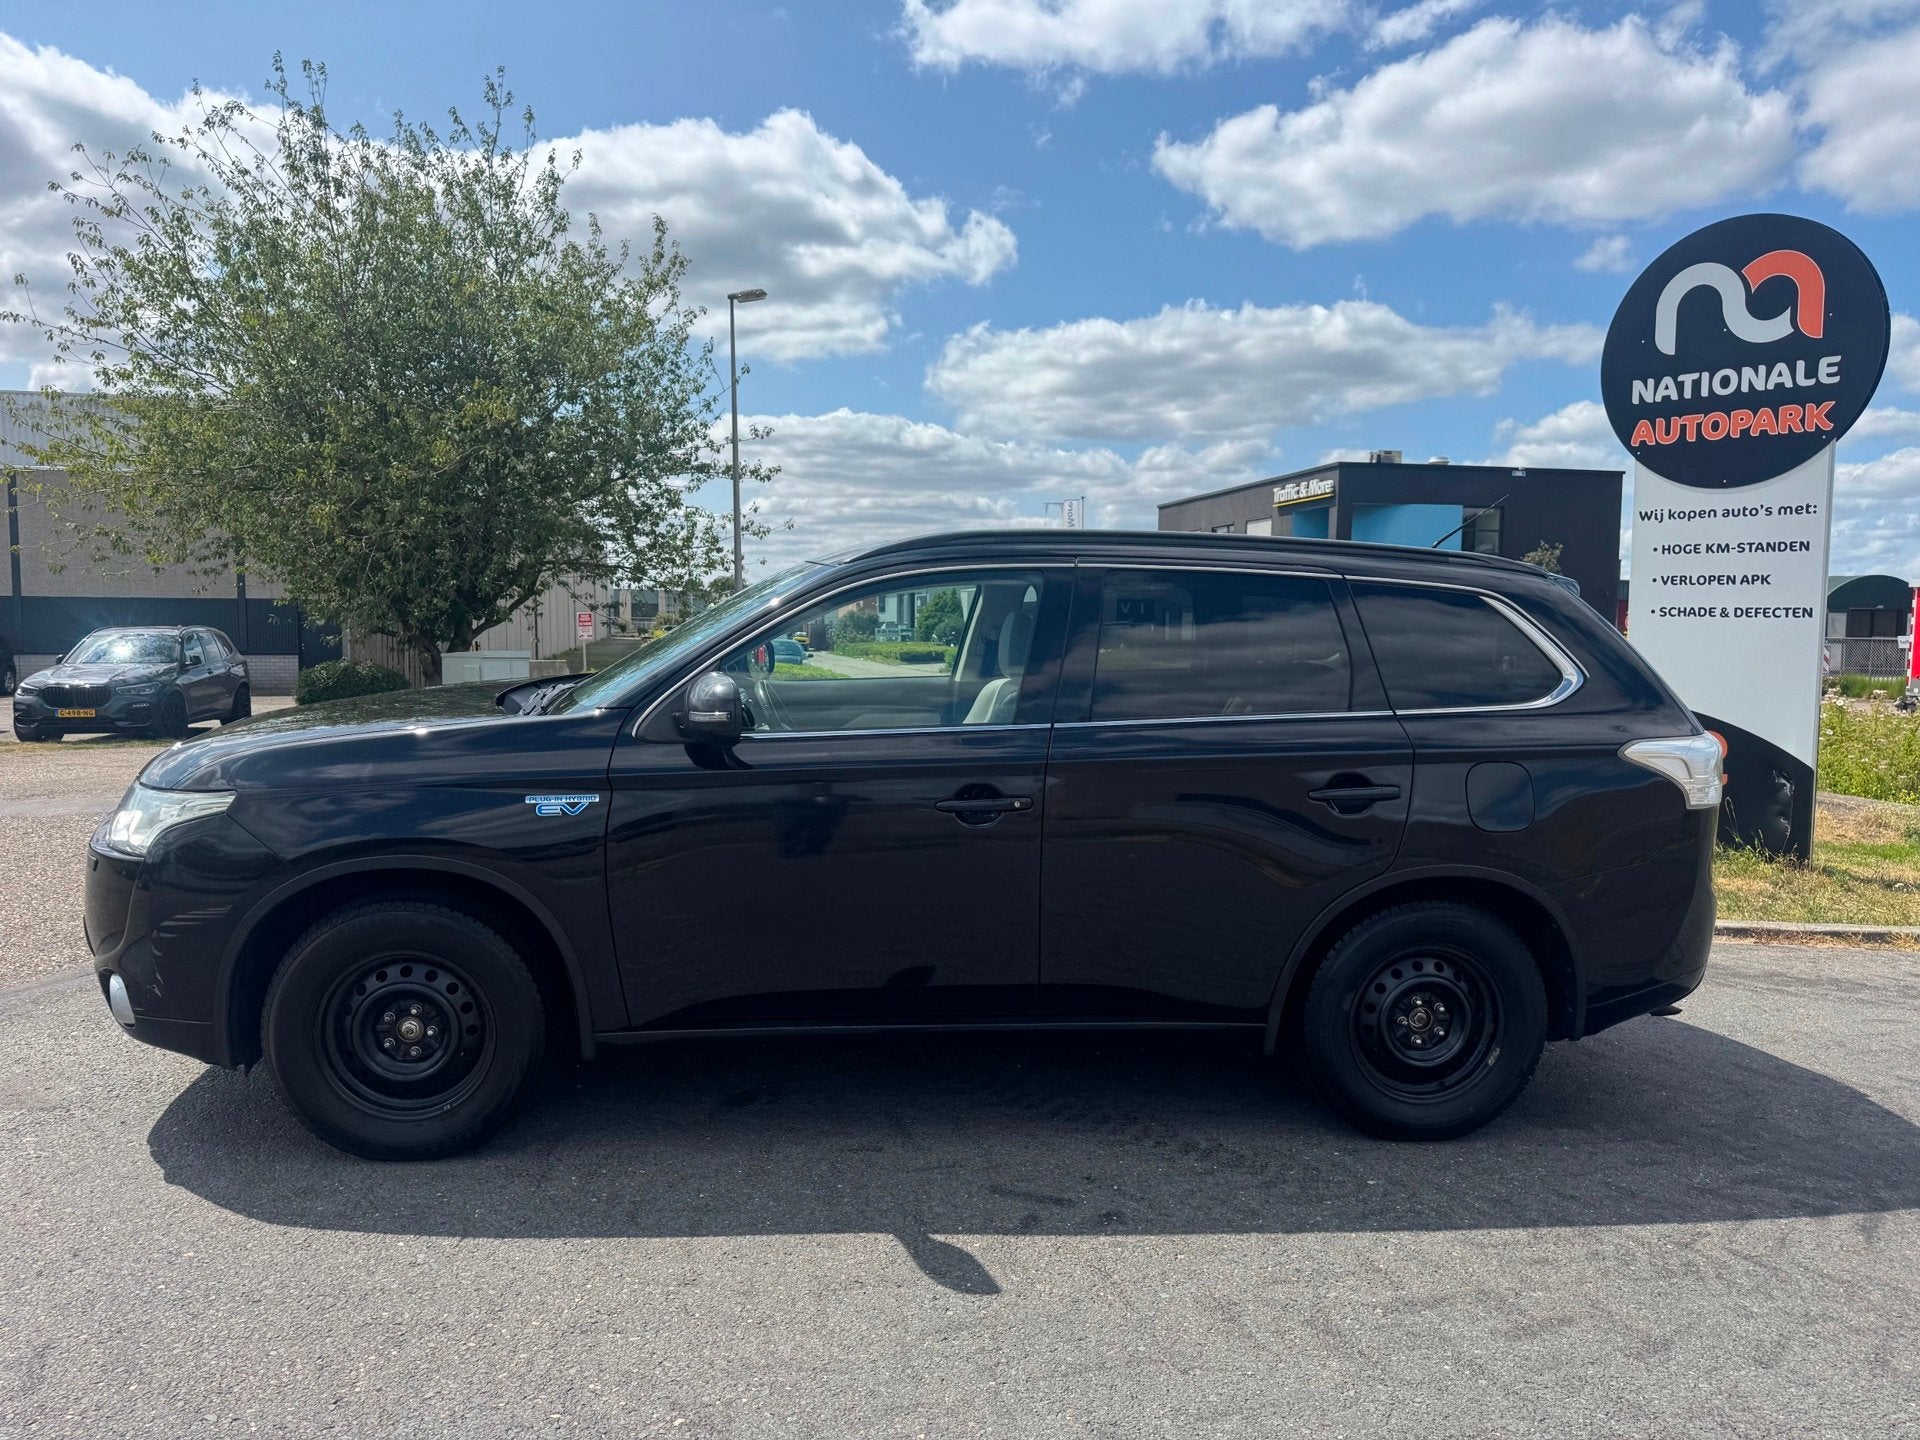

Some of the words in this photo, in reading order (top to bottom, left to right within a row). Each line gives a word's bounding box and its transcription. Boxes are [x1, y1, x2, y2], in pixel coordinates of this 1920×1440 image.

[1631, 355, 1842, 405] NATIONALE
[1630, 400, 1836, 447] AUTOPARK
[1273, 483, 1299, 503] Traffic
[1300, 481, 1309, 498] &
[1309, 479, 1334, 495] More
[1638, 508, 1664, 523] Wij
[1668, 508, 1718, 522] kopen
[1721, 504, 1773, 519] auto's
[1777, 502, 1818, 516] met:
[1661, 543, 1702, 555] HOGE
[1705, 540, 1810, 554] KM-STANDEN
[1660, 574, 1737, 586] VERLOPEN
[1739, 573, 1772, 586] APK
[1659, 606, 1717, 618] SCHADE
[1719, 606, 1730, 618] &
[1733, 606, 1814, 619] DEFECTEN
[535, 802, 590, 817] EV
